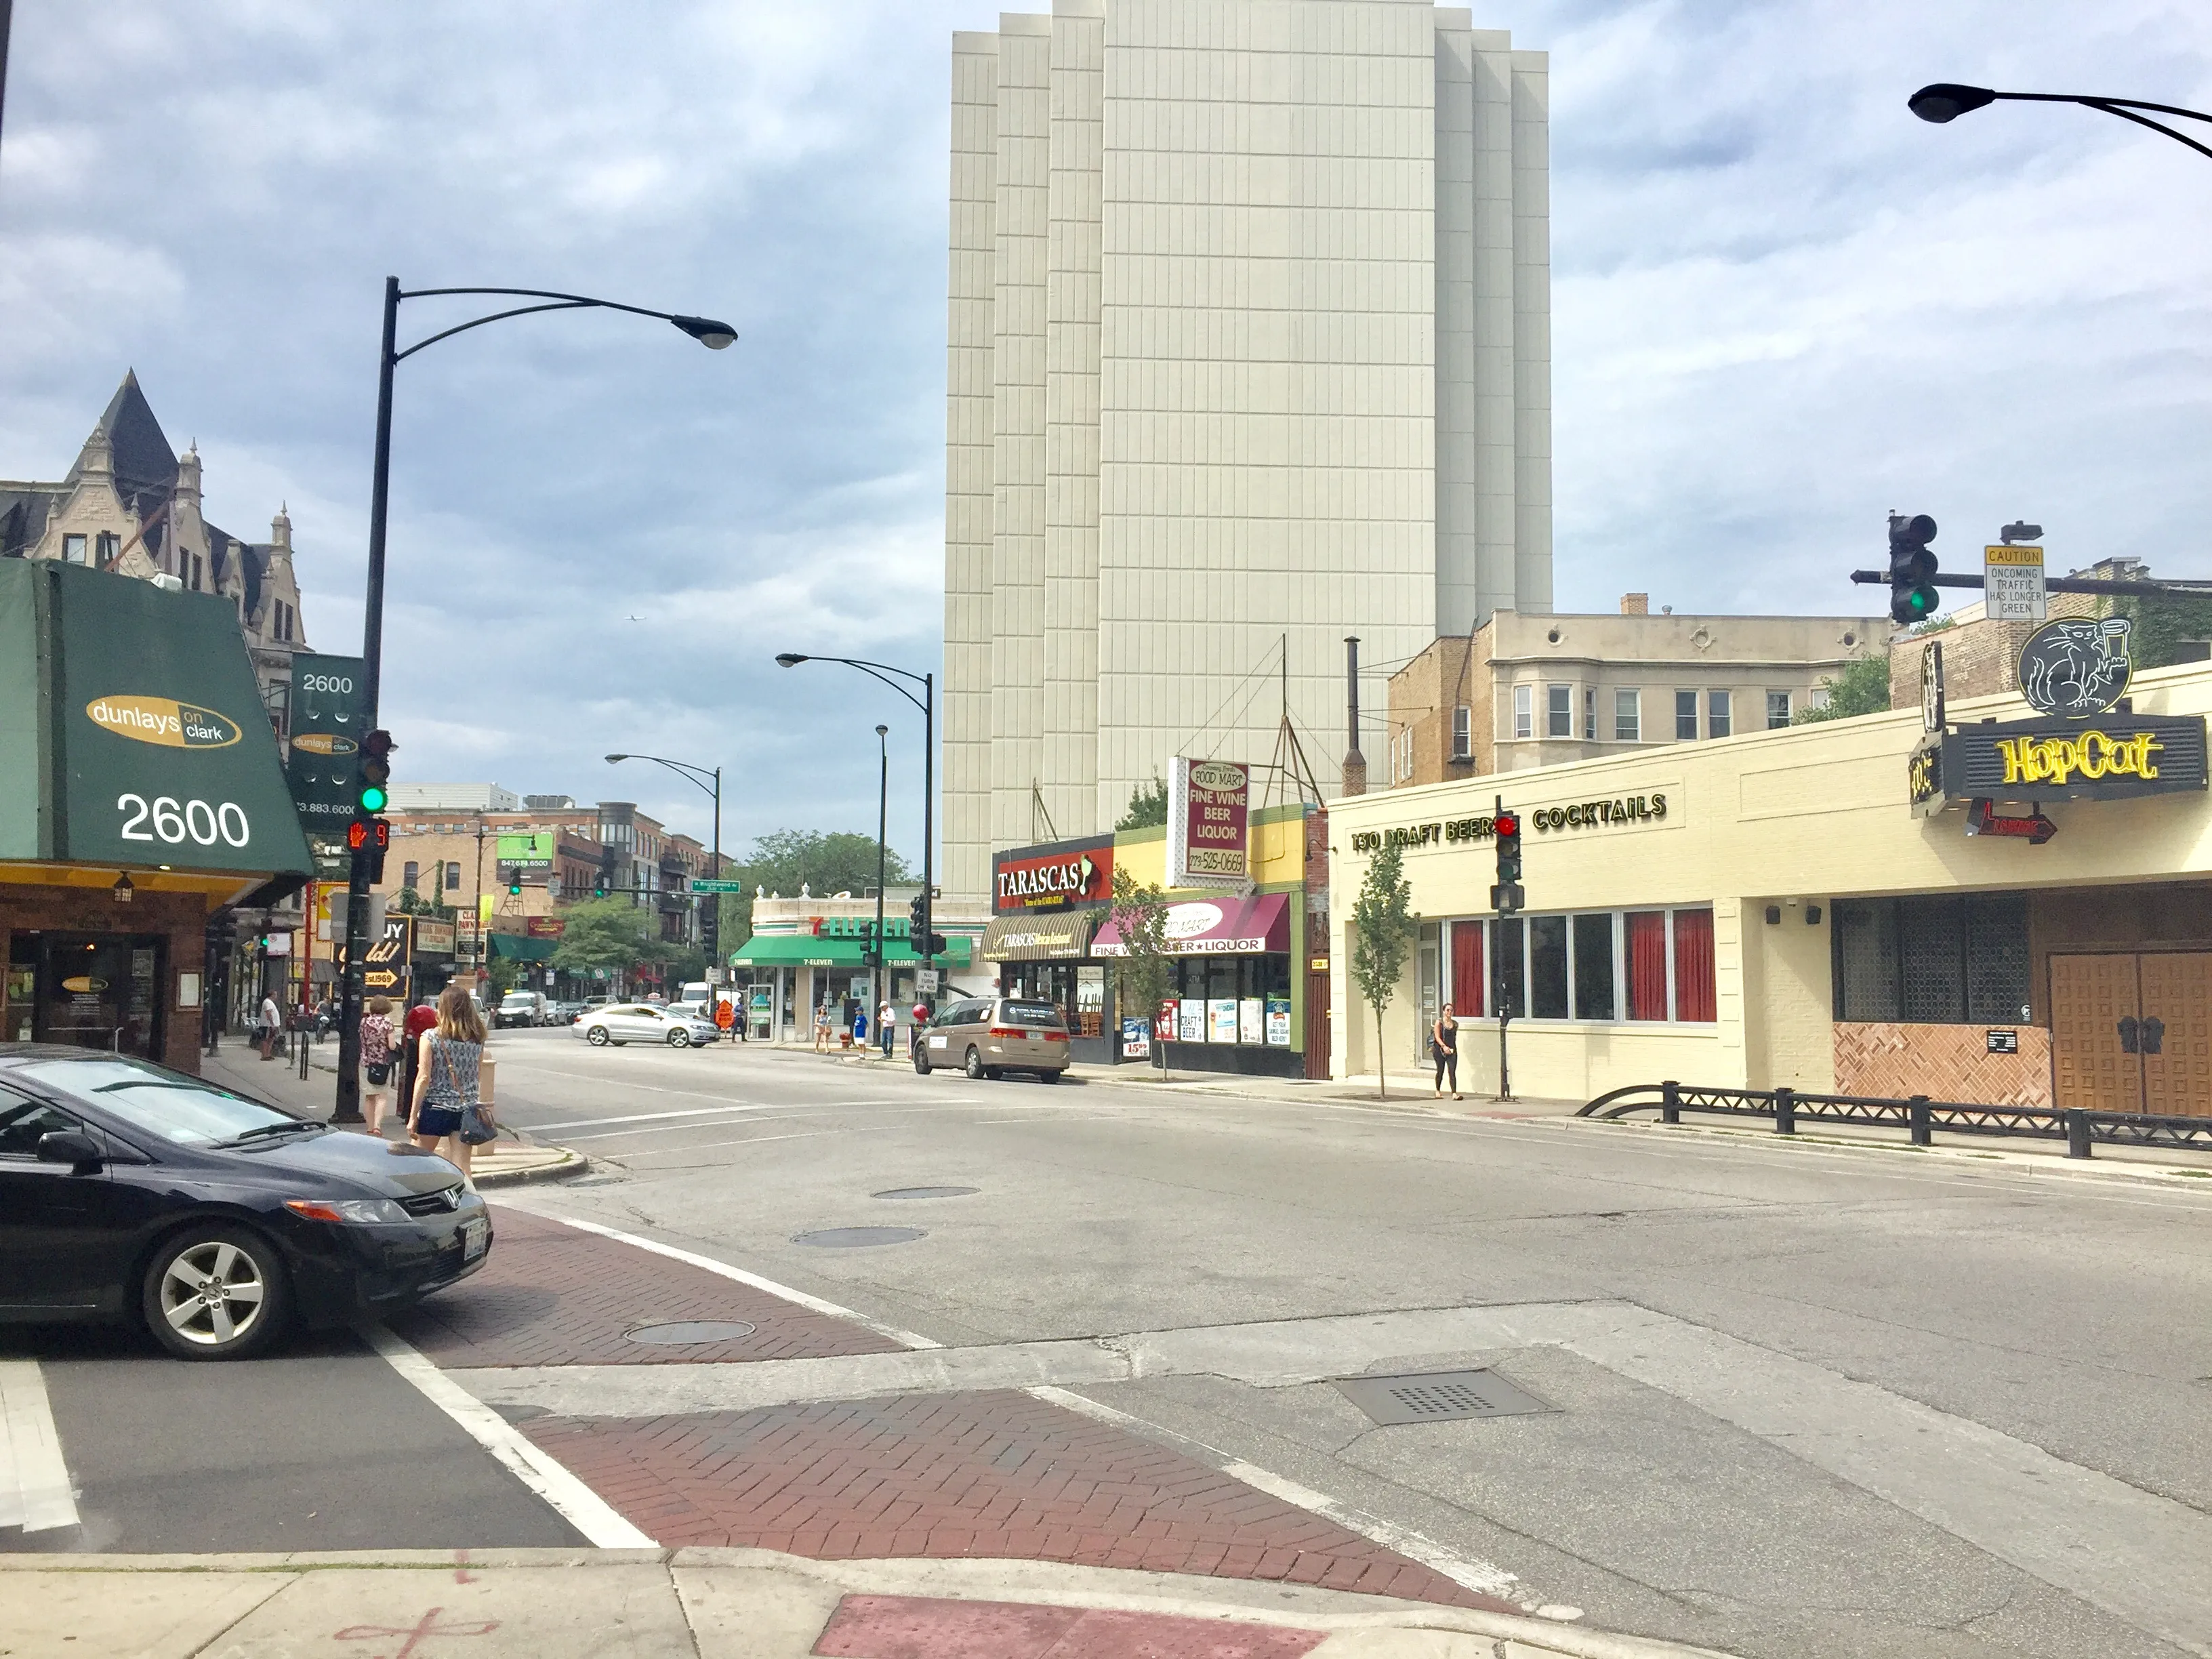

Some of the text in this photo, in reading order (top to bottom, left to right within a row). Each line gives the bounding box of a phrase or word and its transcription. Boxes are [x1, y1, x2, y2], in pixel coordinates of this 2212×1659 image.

[1989, 551, 2039, 562] CAUTION
[1991, 568, 2038, 578] ONCOMING
[1996, 579, 2034, 590] TRAFFIC
[1990, 592, 2041, 601] HAS LONGER
[2001, 603, 2031, 613] GREEN
[303, 674, 352, 693] 2600
[94, 701, 180, 735] dunlays
[184, 712, 203, 724] on
[186, 724, 223, 740] clark
[294, 737, 331, 749] dunlays
[1996, 730, 2164, 785] HopCat
[1195, 771, 1243, 786] FOOD MART
[1190, 790, 1246, 806] FINE WINE
[117, 793, 249, 847] 2600
[1204, 807, 1231, 821] BEER
[1352, 832, 1380, 851] 130
[1385, 823, 1441, 846] DRAFT
[1532, 794, 1666, 830] COCKTAILS
[377, 825, 386, 846] 9
[1197, 824, 1237, 840] LIQUOR
[1189, 852, 1243, 872] 773-525-0669
[998, 863, 1078, 897] TARASCAS
[383, 924, 403, 939] UY
[1004, 933, 1035, 947] TARASCAS
[1096, 947, 1118, 956] FINE
[1206, 940, 1258, 951] LIQUOR
[1181, 1016, 1197, 1027] CRAFT
[1183, 1027, 1195, 1038] BEER
